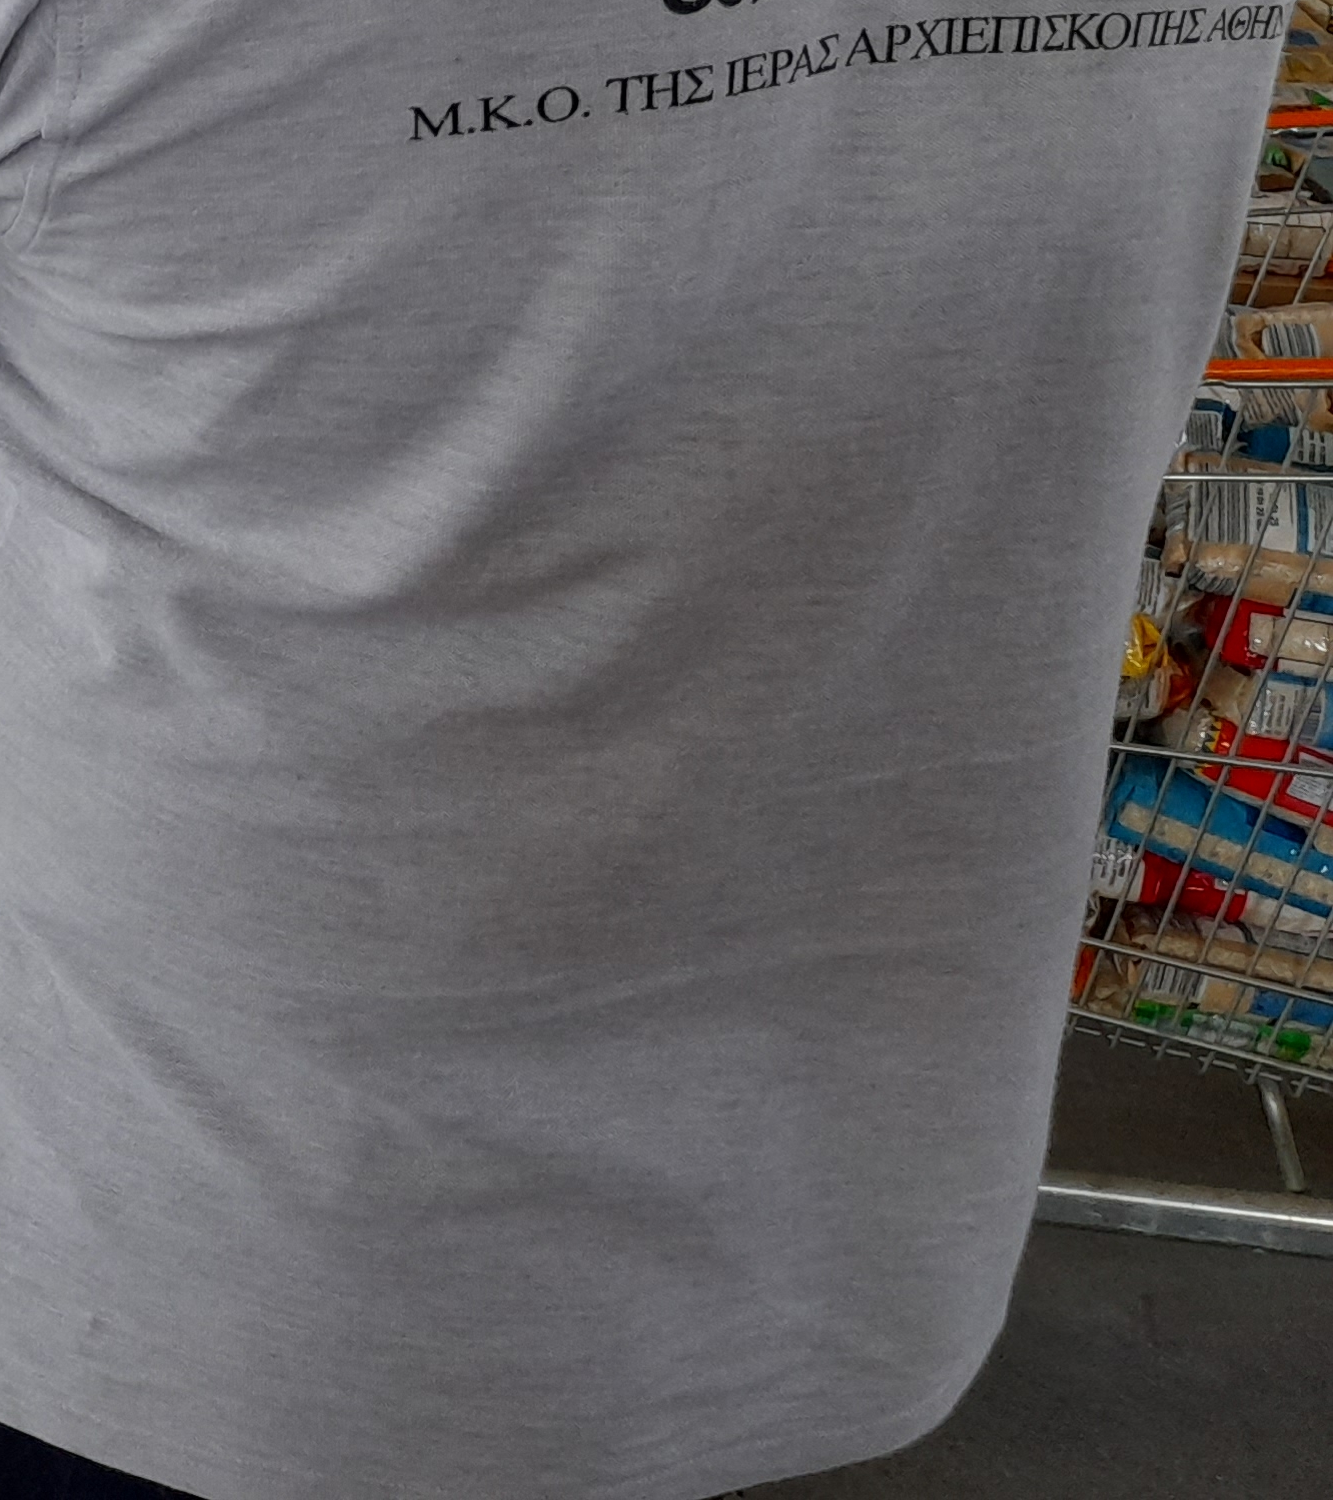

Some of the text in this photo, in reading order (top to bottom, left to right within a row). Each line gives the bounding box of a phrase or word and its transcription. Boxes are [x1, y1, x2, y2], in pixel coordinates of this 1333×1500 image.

[409, 85, 591, 141] Μ.Κ.Ο.
[605, 65, 714, 115] ΤΗΣ
[725, 33, 840, 97] ΙΕΡΑΣ
[844, 7, 1207, 67] ΑΡΧΙΕΠΙΣΚΟΠΗΣ
